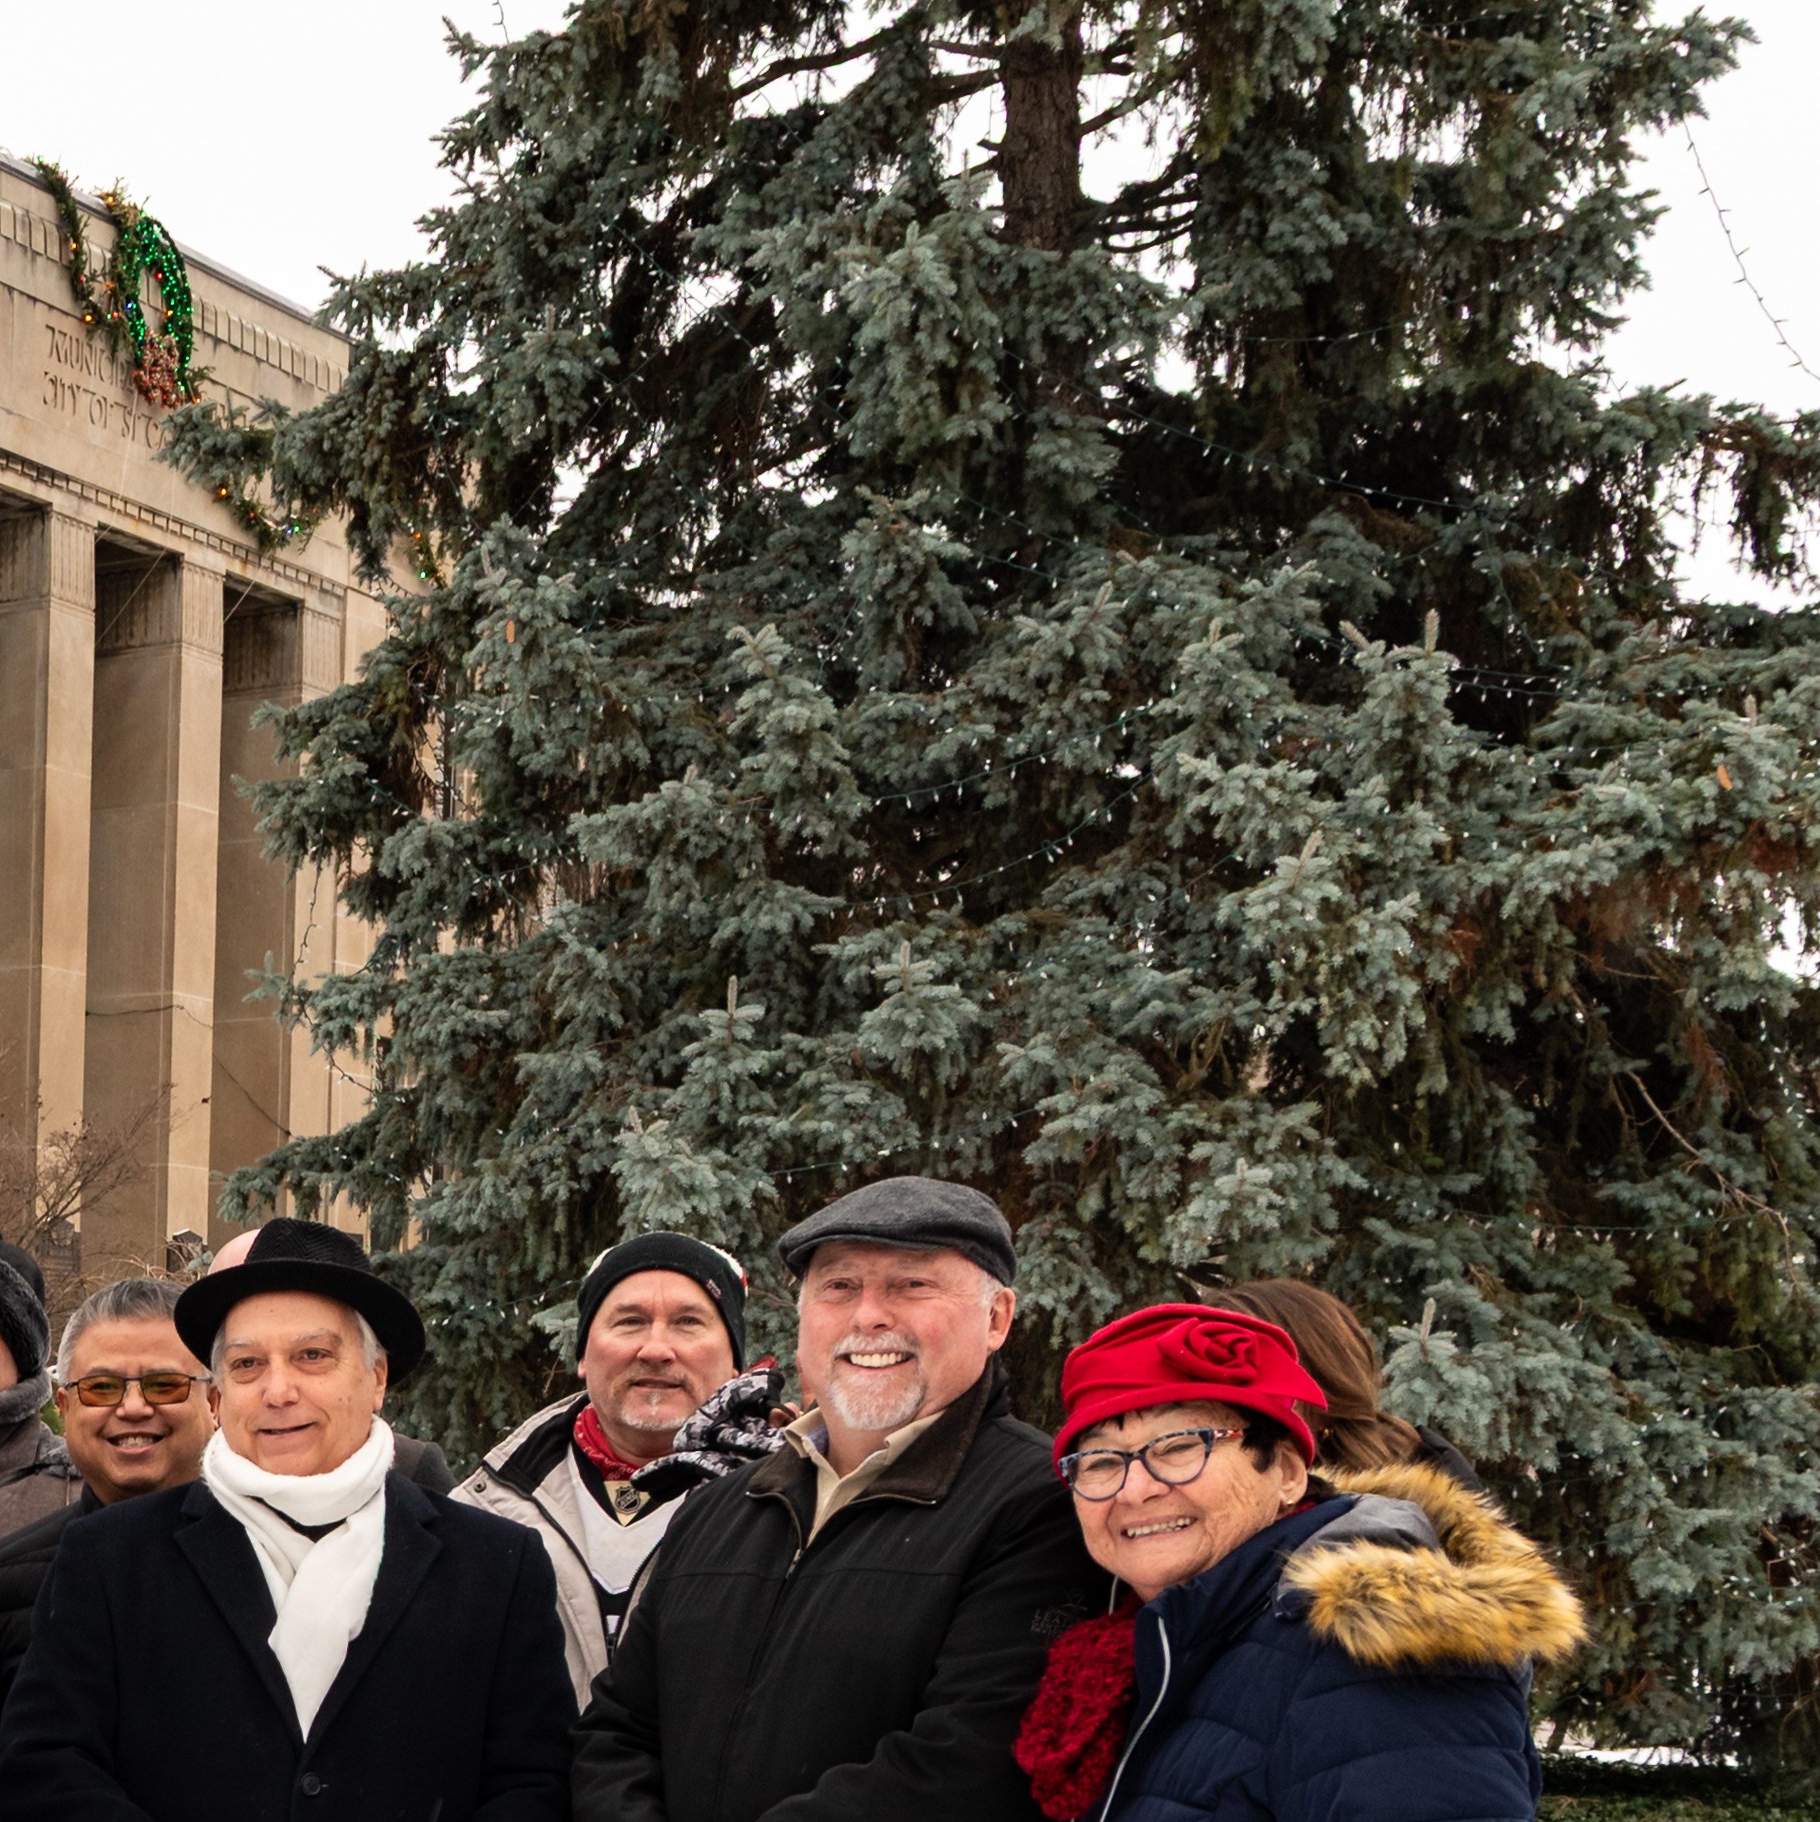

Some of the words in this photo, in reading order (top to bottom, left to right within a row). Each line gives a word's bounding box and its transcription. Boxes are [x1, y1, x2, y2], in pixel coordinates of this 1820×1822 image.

[45, 324, 136, 394] MUNICIPA
[43, 371, 81, 417] CITY
[87, 391, 114, 430] OF
